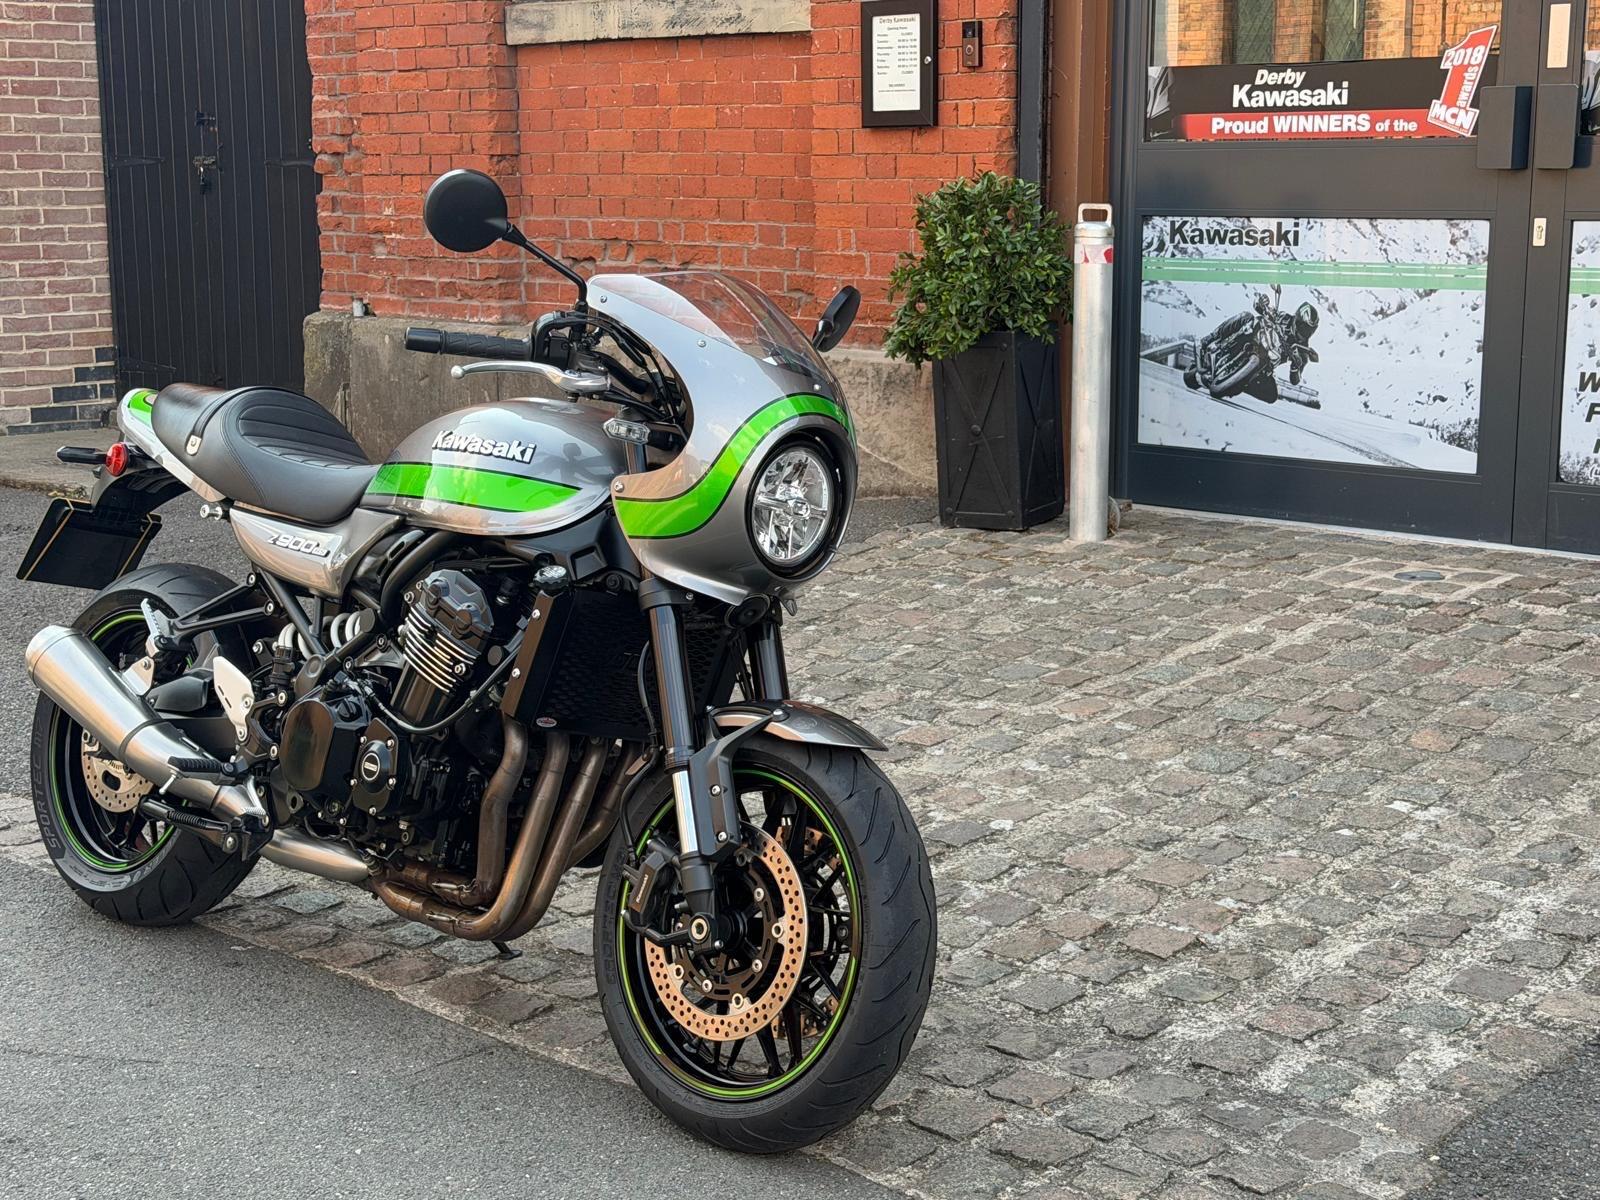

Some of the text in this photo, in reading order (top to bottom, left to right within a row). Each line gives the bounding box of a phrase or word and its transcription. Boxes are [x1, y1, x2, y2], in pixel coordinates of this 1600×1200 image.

[1445, 45, 1486, 67] 2018
[1254, 68, 1306, 88] Derby
[1456, 65, 1479, 108] awards
[1232, 81, 1349, 108] Kawasaki
[1211, 116, 1269, 134] Proud
[1273, 113, 1371, 133] WINNERS
[1375, 118, 1391, 132] of
[1393, 119, 1418, 132] the
[1431, 103, 1475, 130] MCN
[1168, 220, 1300, 247] Kawasaki
[432, 430, 537, 464] Kawasaki
